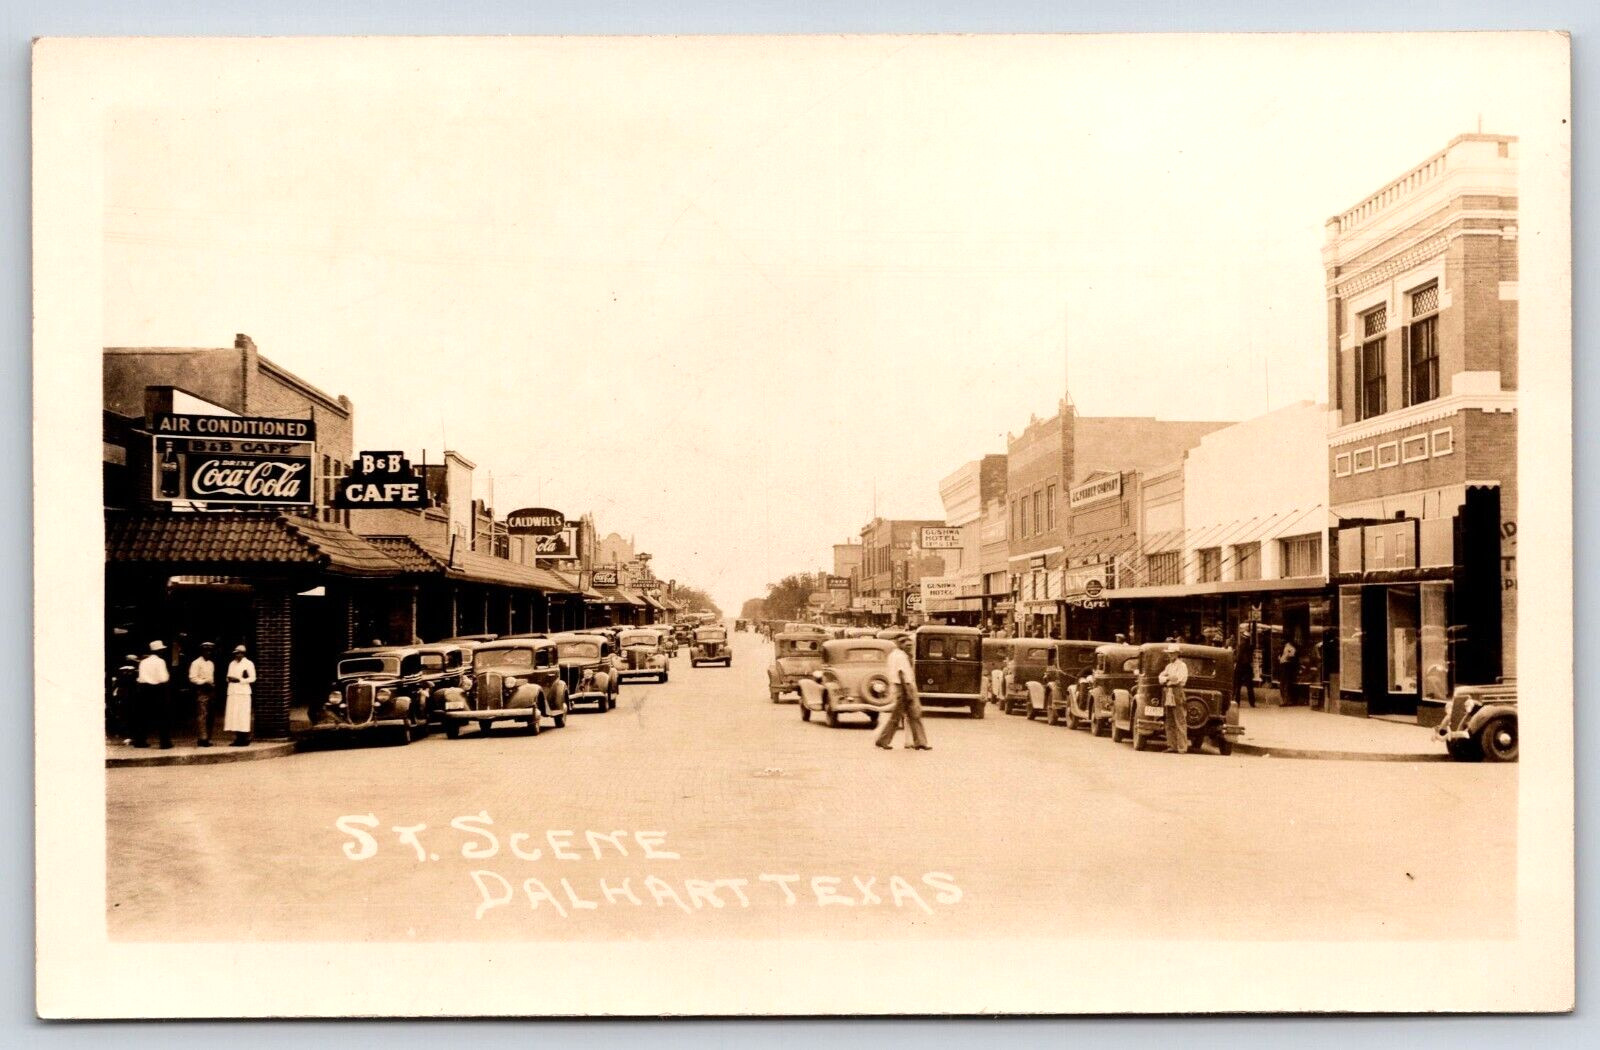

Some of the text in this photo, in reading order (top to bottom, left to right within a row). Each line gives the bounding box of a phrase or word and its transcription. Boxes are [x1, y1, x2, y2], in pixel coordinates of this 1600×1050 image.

[160, 417, 308, 437] AIR CONDITIONED
[191, 440, 293, 454] B&B CAFE
[361, 453, 402, 474] B&B
[191, 459, 307, 498] Coca-Cola
[345, 483, 420, 502] CAFE
[508, 515, 562, 528] CALDWELLS
